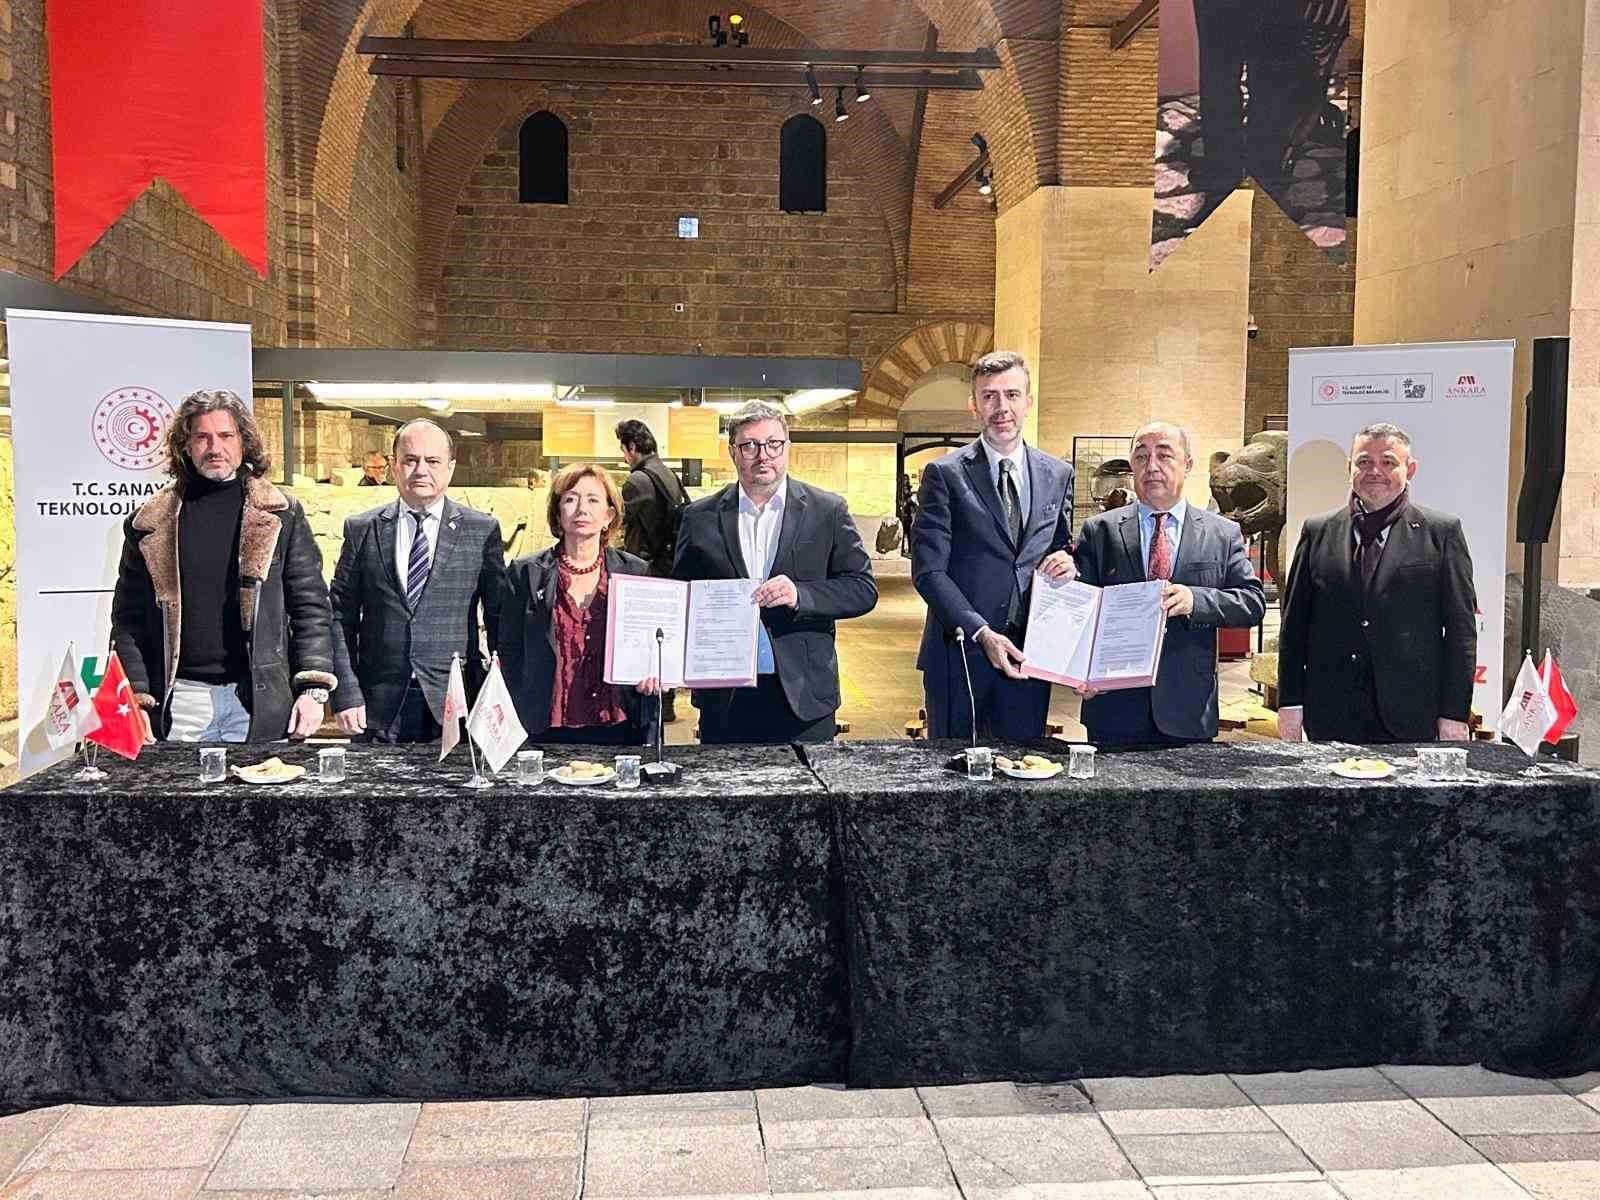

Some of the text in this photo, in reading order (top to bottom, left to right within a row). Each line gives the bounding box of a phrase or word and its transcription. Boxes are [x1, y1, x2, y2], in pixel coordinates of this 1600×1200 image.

[72, 482, 168, 496] T.C. SANAY
[37, 499, 136, 516] TEKNOLOJİ
